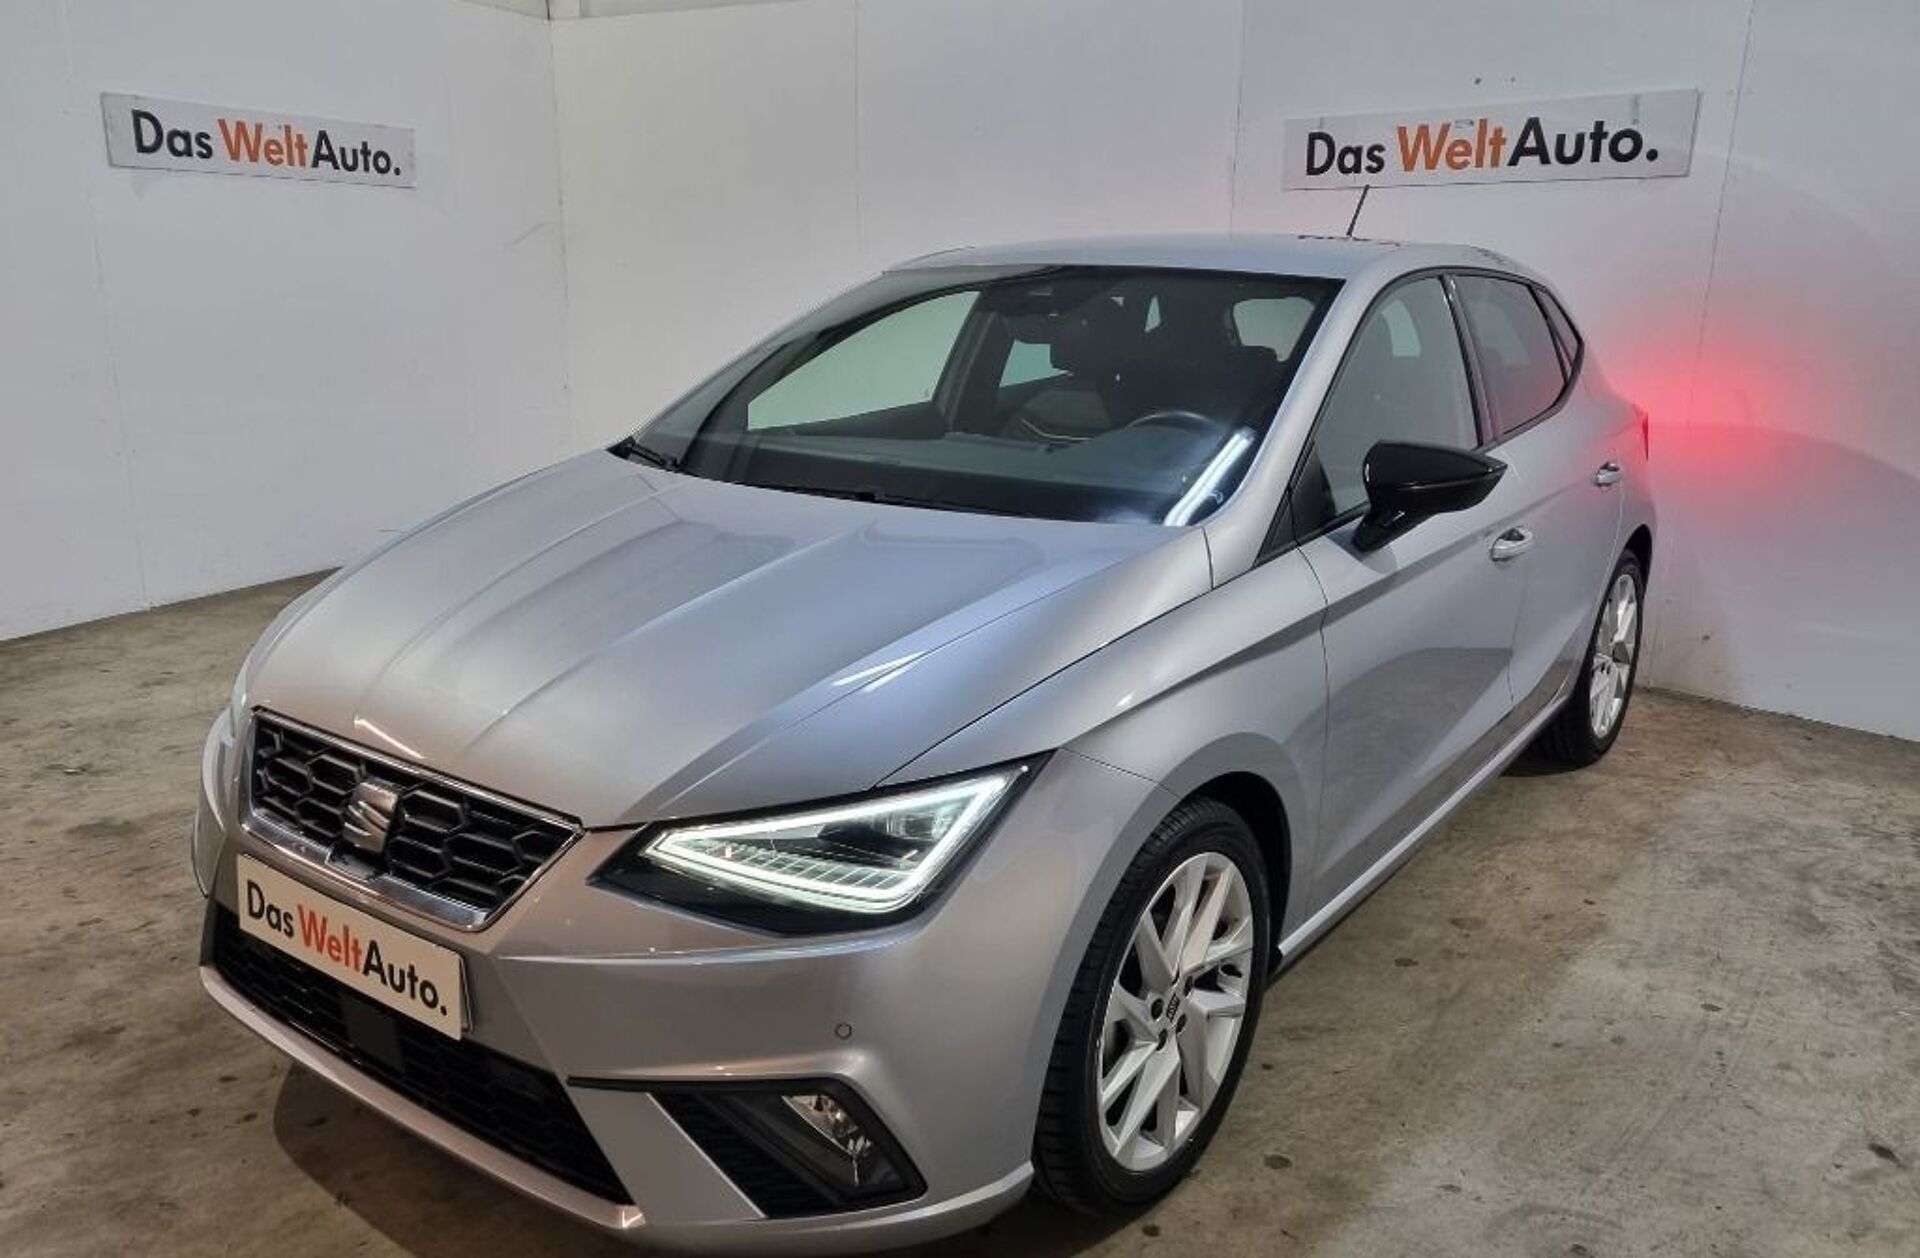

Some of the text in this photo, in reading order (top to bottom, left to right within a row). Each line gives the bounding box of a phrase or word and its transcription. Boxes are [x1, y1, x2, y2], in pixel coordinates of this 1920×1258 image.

[131, 109, 213, 159] Das
[1306, 131, 1386, 176] Das
[247, 880, 294, 938] Das
